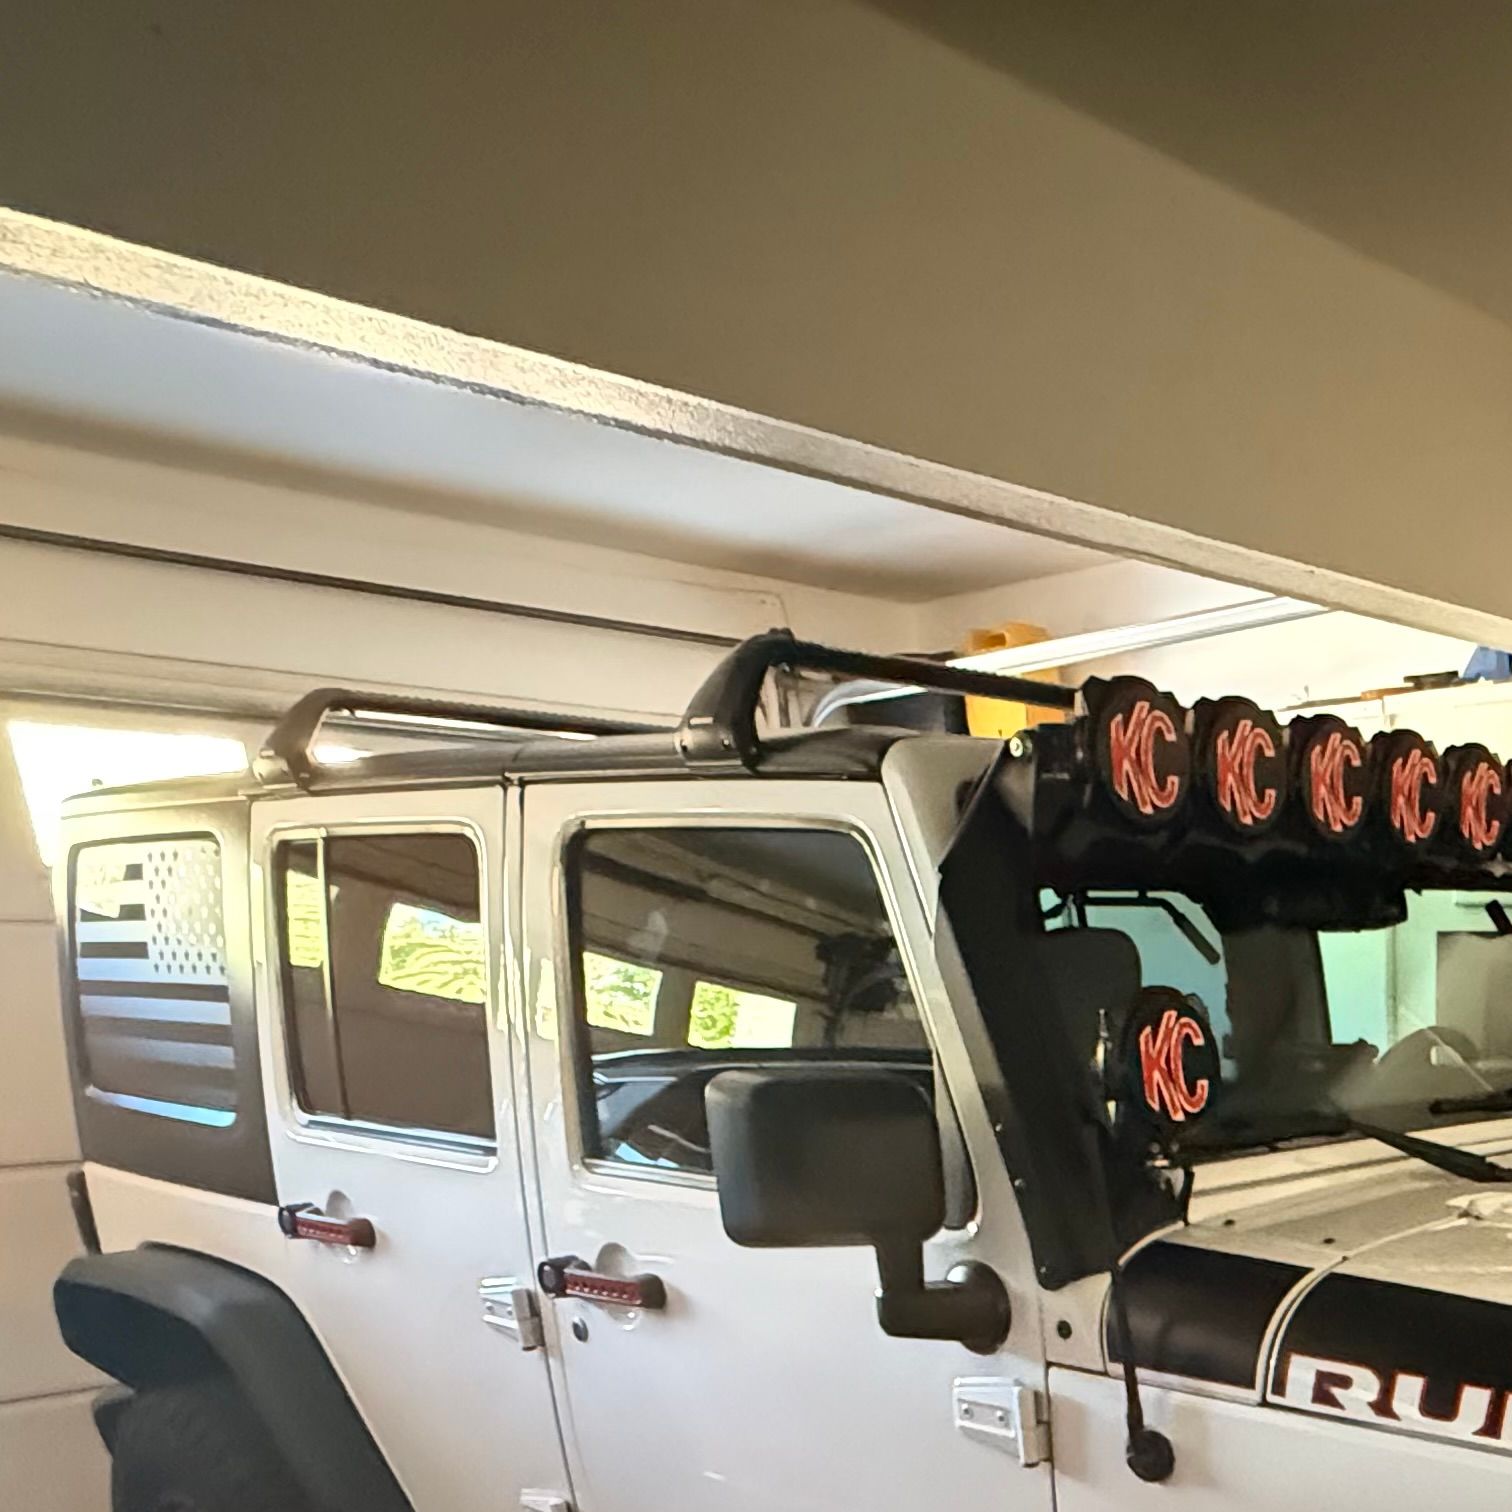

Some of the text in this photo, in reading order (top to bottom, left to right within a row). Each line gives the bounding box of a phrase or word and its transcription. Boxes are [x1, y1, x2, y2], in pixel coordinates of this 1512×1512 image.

[1110, 701, 1179, 814] KC
[1216, 720, 1275, 825] KC
[1310, 732, 1362, 832] KC
[1391, 748, 1438, 843] KC
[1460, 762, 1501, 850] KC
[1140, 1010, 1208, 1121] KC
